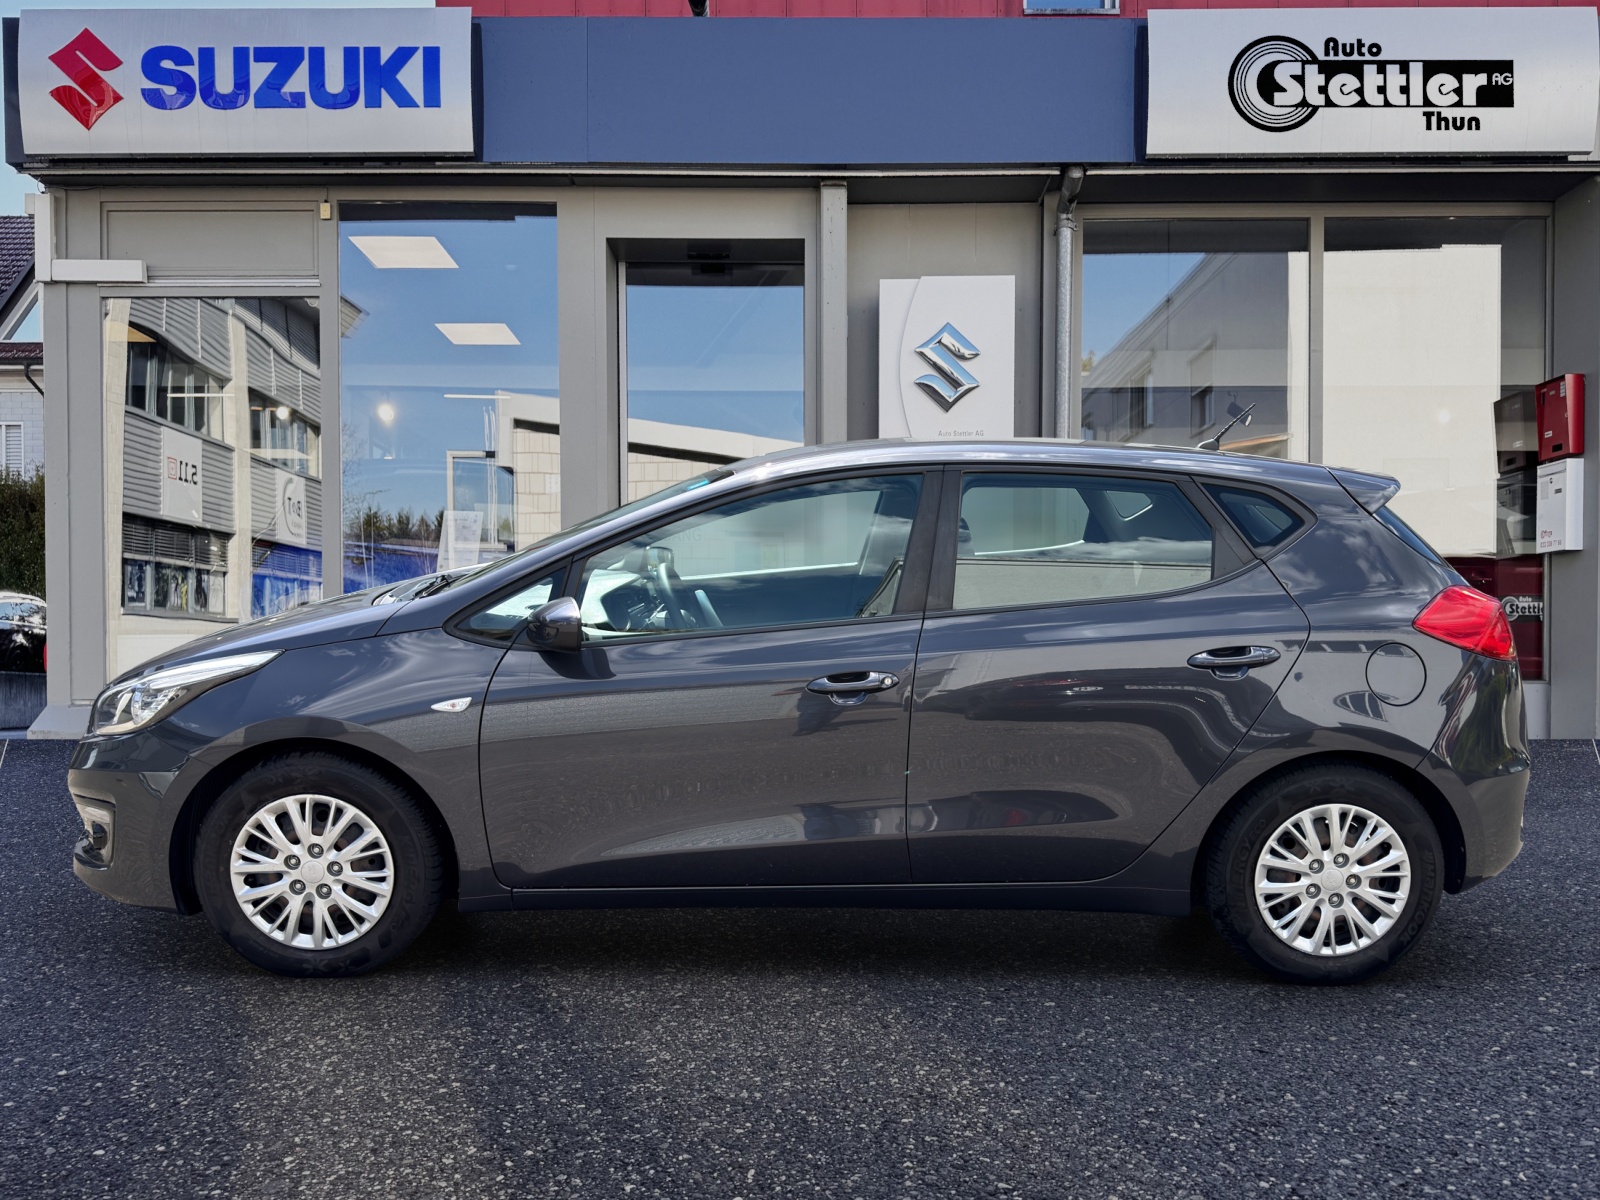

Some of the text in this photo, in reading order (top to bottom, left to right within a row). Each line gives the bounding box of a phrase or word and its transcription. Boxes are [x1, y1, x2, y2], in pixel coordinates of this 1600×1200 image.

[1323, 37, 1382, 58] Auto
[140, 45, 442, 111] SUZUKI
[1273, 61, 1513, 107] Stettler AG
[1422, 110, 1481, 131] Thun
[975, 429, 984, 437] AG
